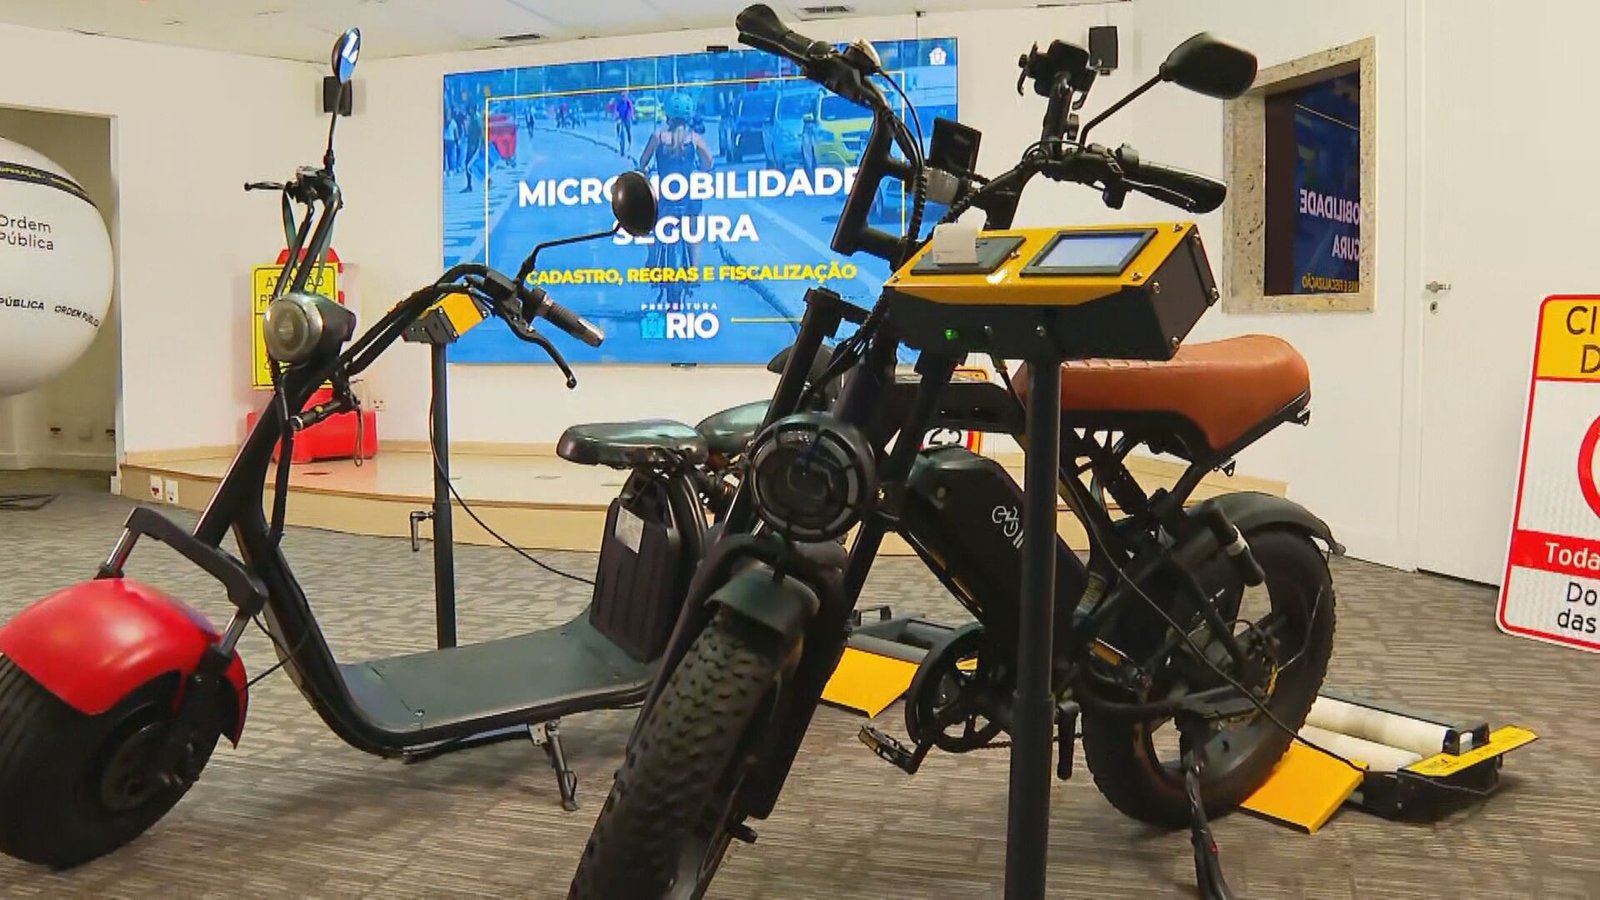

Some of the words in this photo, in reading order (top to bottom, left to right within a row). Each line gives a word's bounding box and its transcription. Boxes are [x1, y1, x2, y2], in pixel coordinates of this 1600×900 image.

[518, 167, 860, 208] MICROBILIDAD
[0, 214, 51, 233] Ordem
[612, 214, 759, 246] SGURA
[526, 267, 623, 286] CADASTRO,
[627, 266, 699, 283] REGRAS
[703, 266, 715, 282] E
[719, 260, 857, 285] FISCALIZAÇÃO
[641, 303, 718, 311] PREFEITURA
[666, 313, 719, 339] RIO
[1545, 541, 1600, 571] Toda
[1566, 581, 1598, 606] Do
[1557, 608, 1597, 634] das
